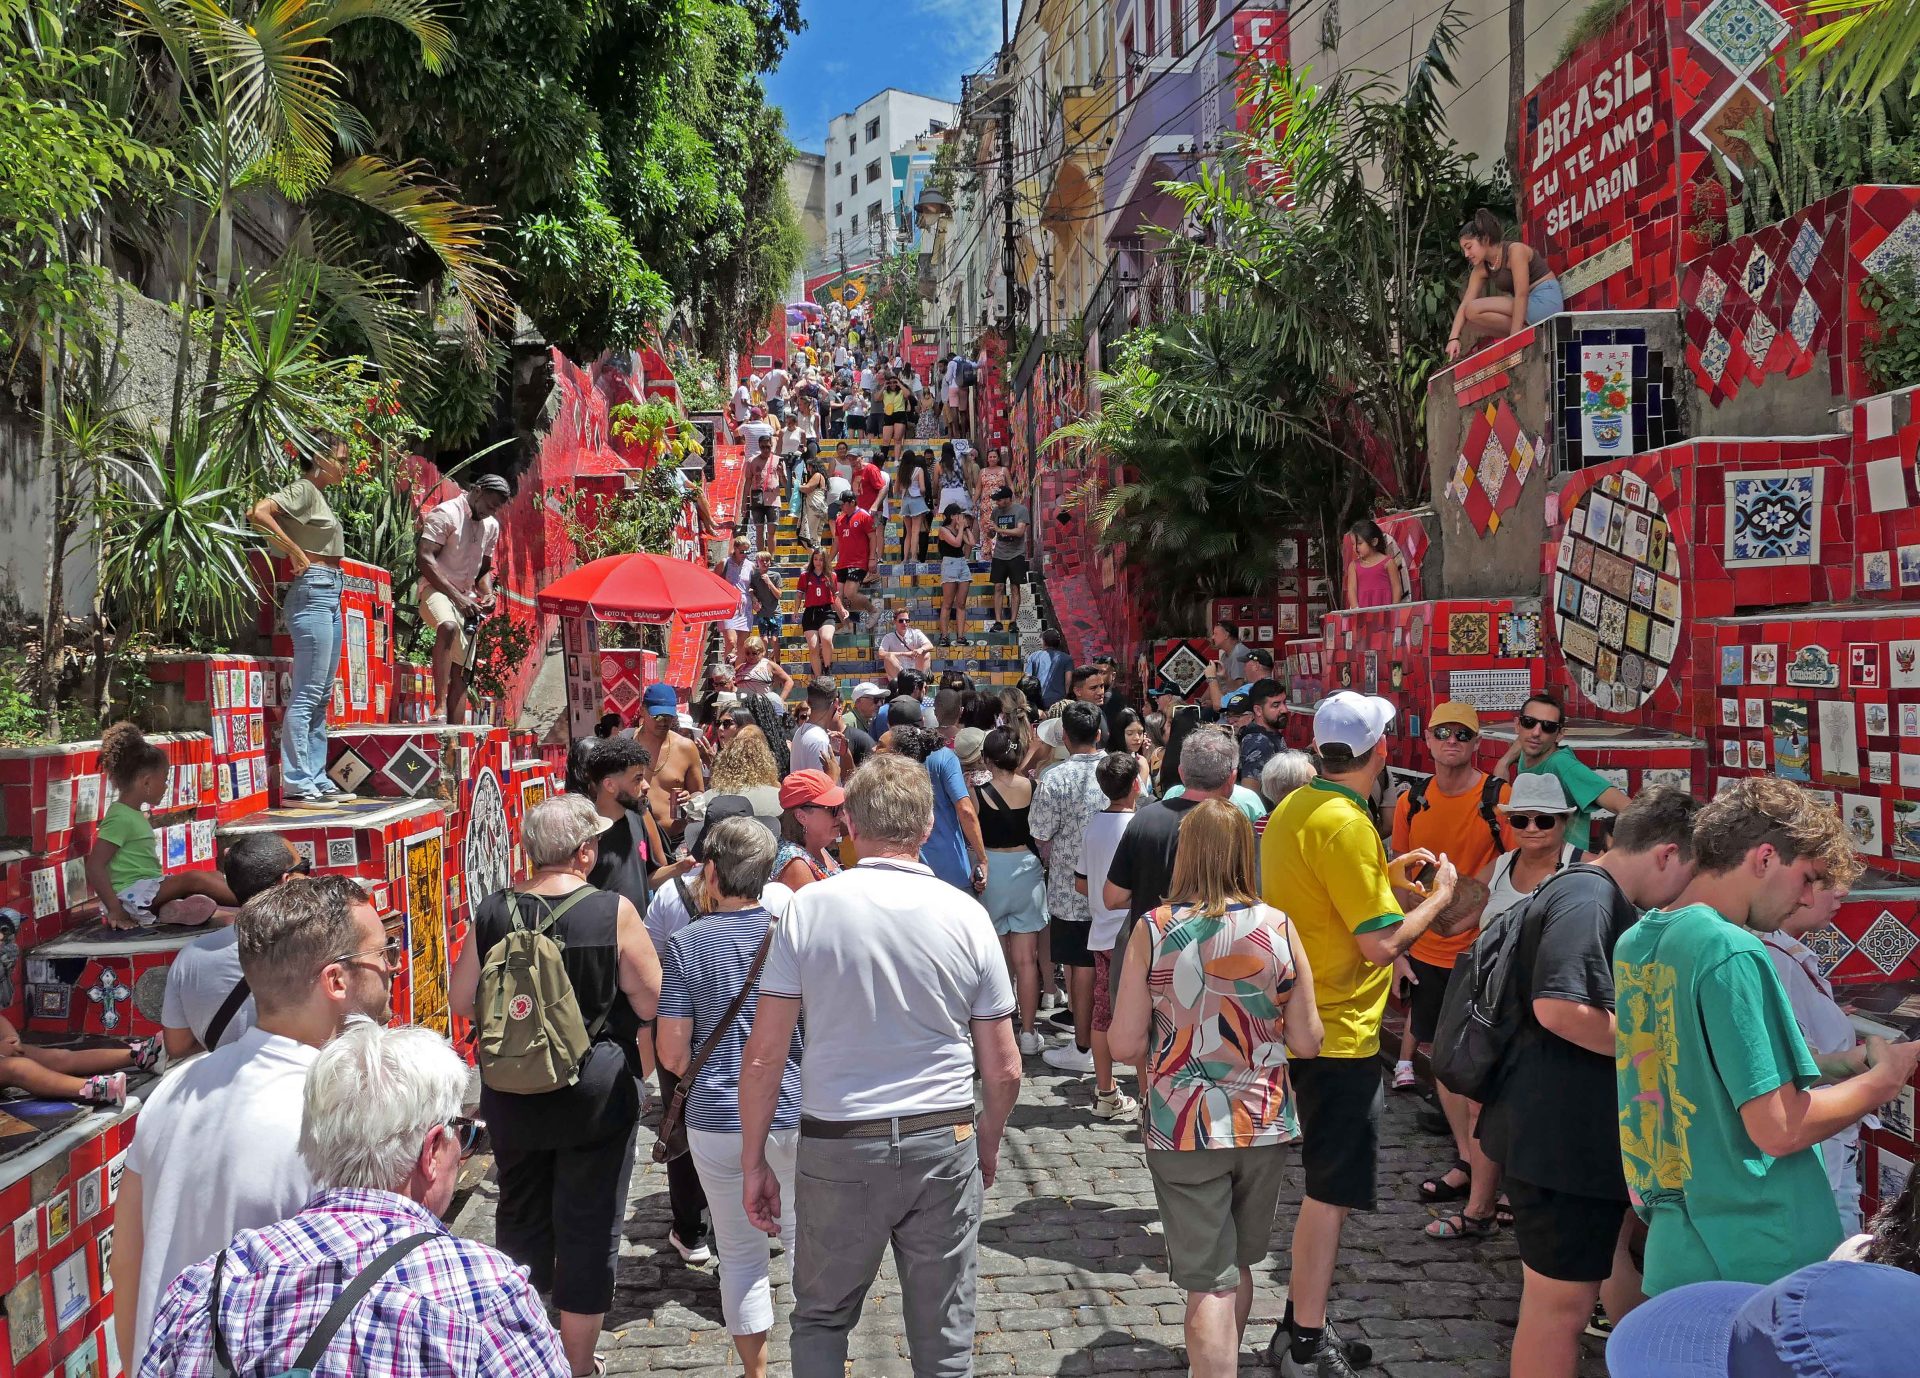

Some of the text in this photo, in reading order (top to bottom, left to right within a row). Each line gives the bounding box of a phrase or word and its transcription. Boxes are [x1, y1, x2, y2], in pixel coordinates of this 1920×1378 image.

[1533, 105, 1653, 206] EU TE AMO
[1546, 157, 1638, 236] SELARON
[816, 587, 822, 597] 8
